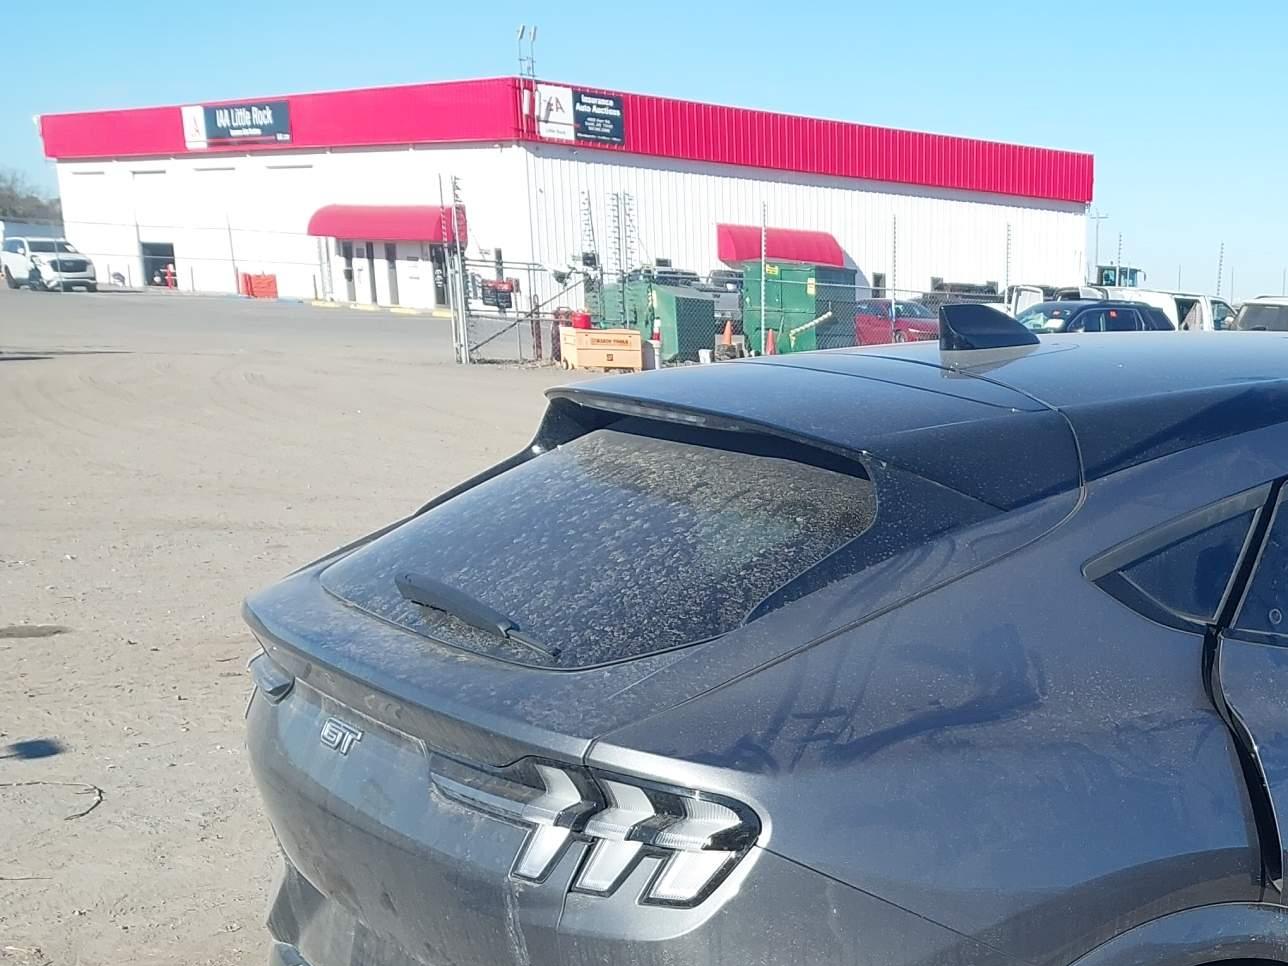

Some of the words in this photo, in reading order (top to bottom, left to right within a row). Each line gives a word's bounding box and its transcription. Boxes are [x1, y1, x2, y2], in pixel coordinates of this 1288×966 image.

[230, 107, 251, 127] Little
[251, 105, 273, 125] Rock
[320, 716, 362, 755] GT
